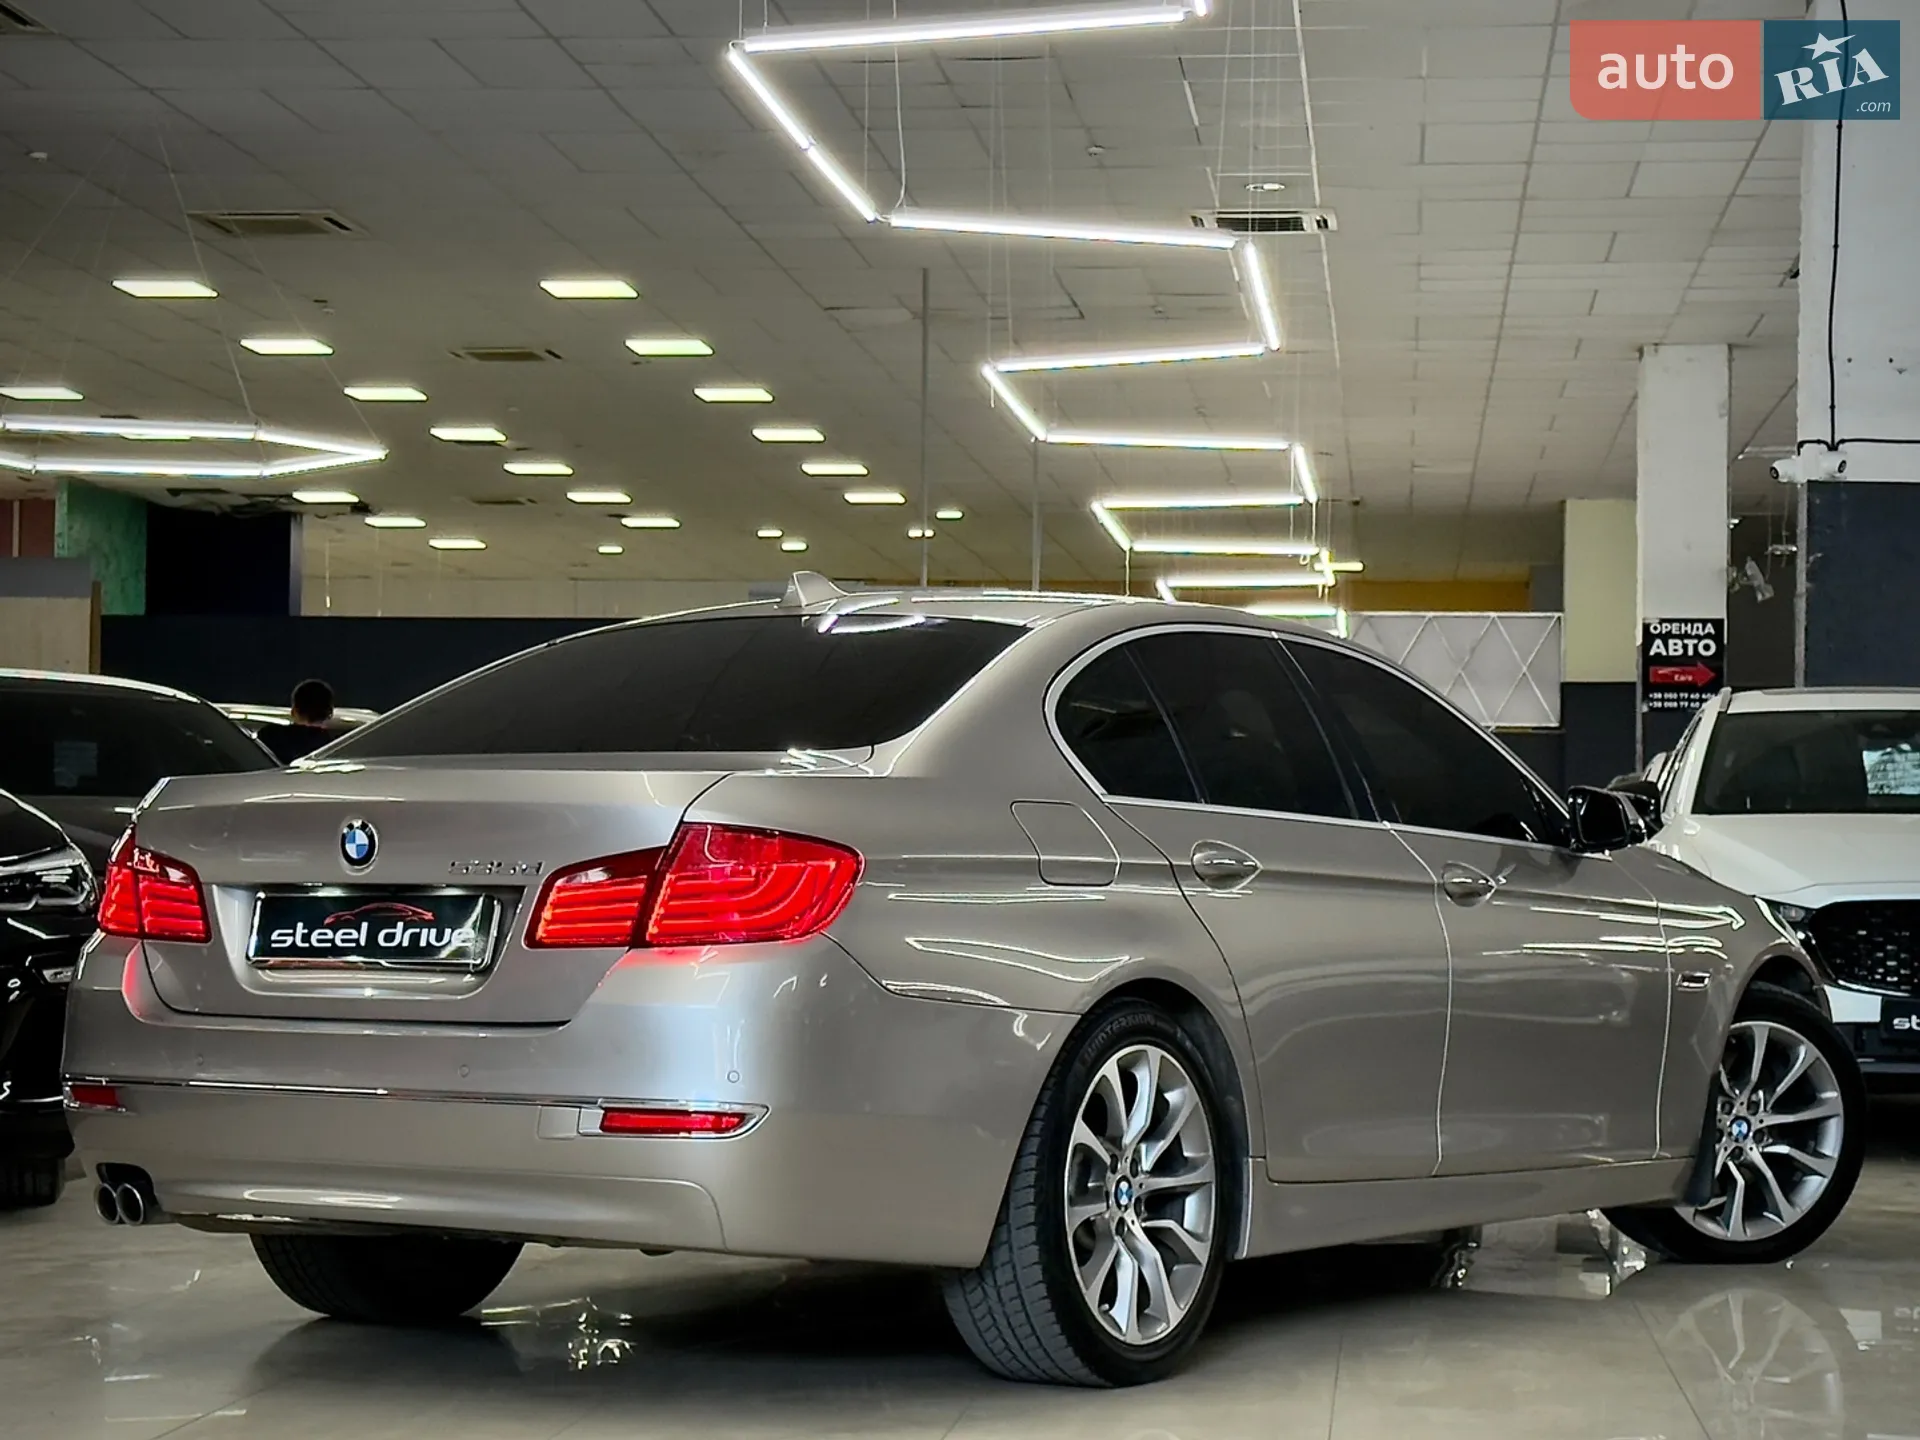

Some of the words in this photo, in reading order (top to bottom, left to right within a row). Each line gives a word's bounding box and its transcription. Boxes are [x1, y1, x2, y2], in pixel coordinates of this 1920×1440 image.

[1649, 622, 1716, 636] ОРЕНДА
[1648, 638, 1717, 657] АВТО
[270, 921, 369, 948] steel
[377, 921, 476, 948] drive
